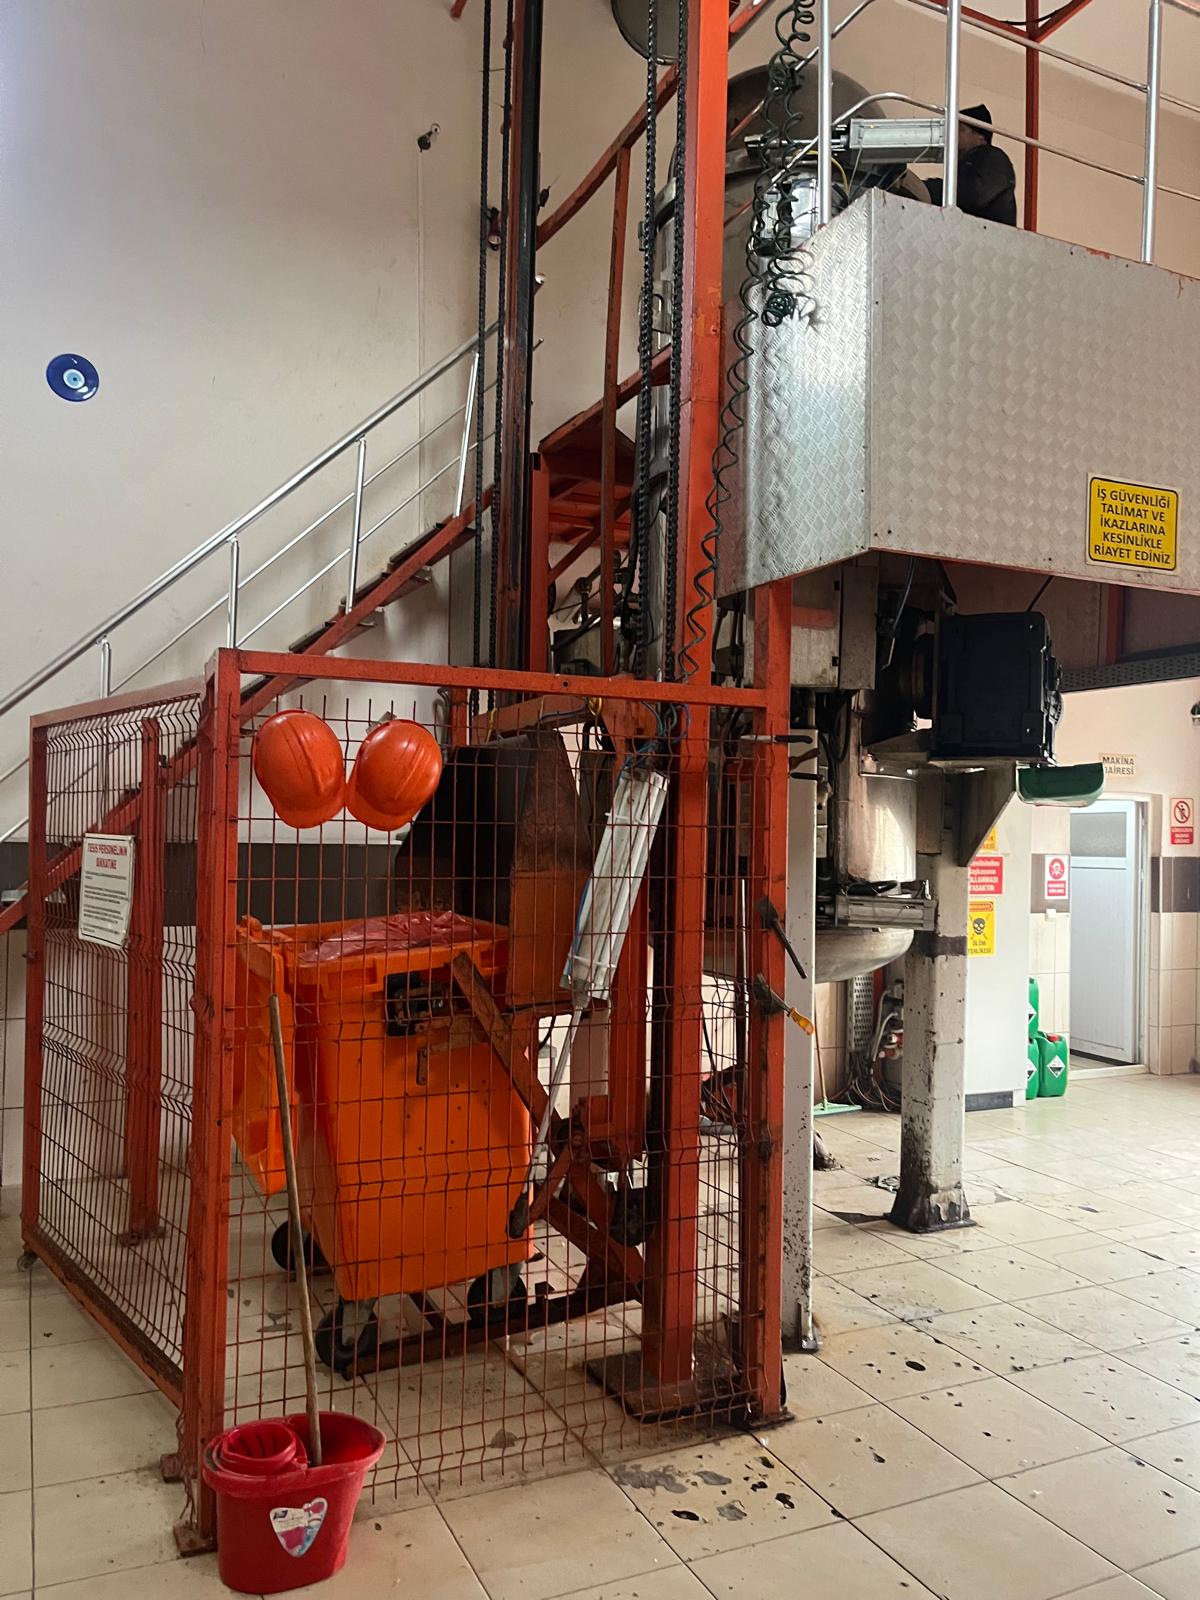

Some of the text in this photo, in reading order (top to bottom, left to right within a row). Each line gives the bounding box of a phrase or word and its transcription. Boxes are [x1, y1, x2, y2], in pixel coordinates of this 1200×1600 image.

[1097, 486, 1170, 509] İŞ GÜVENLİĞİ
[1101, 503, 1165, 522] TALİMAT VE
[1100, 515, 1166, 536] İKAZLARINA
[1103, 531, 1162, 549] KESİNLİKLE
[1094, 543, 1171, 564] RİAYET EDİNİZ
[1102, 755, 1135, 765] MAKİNA
